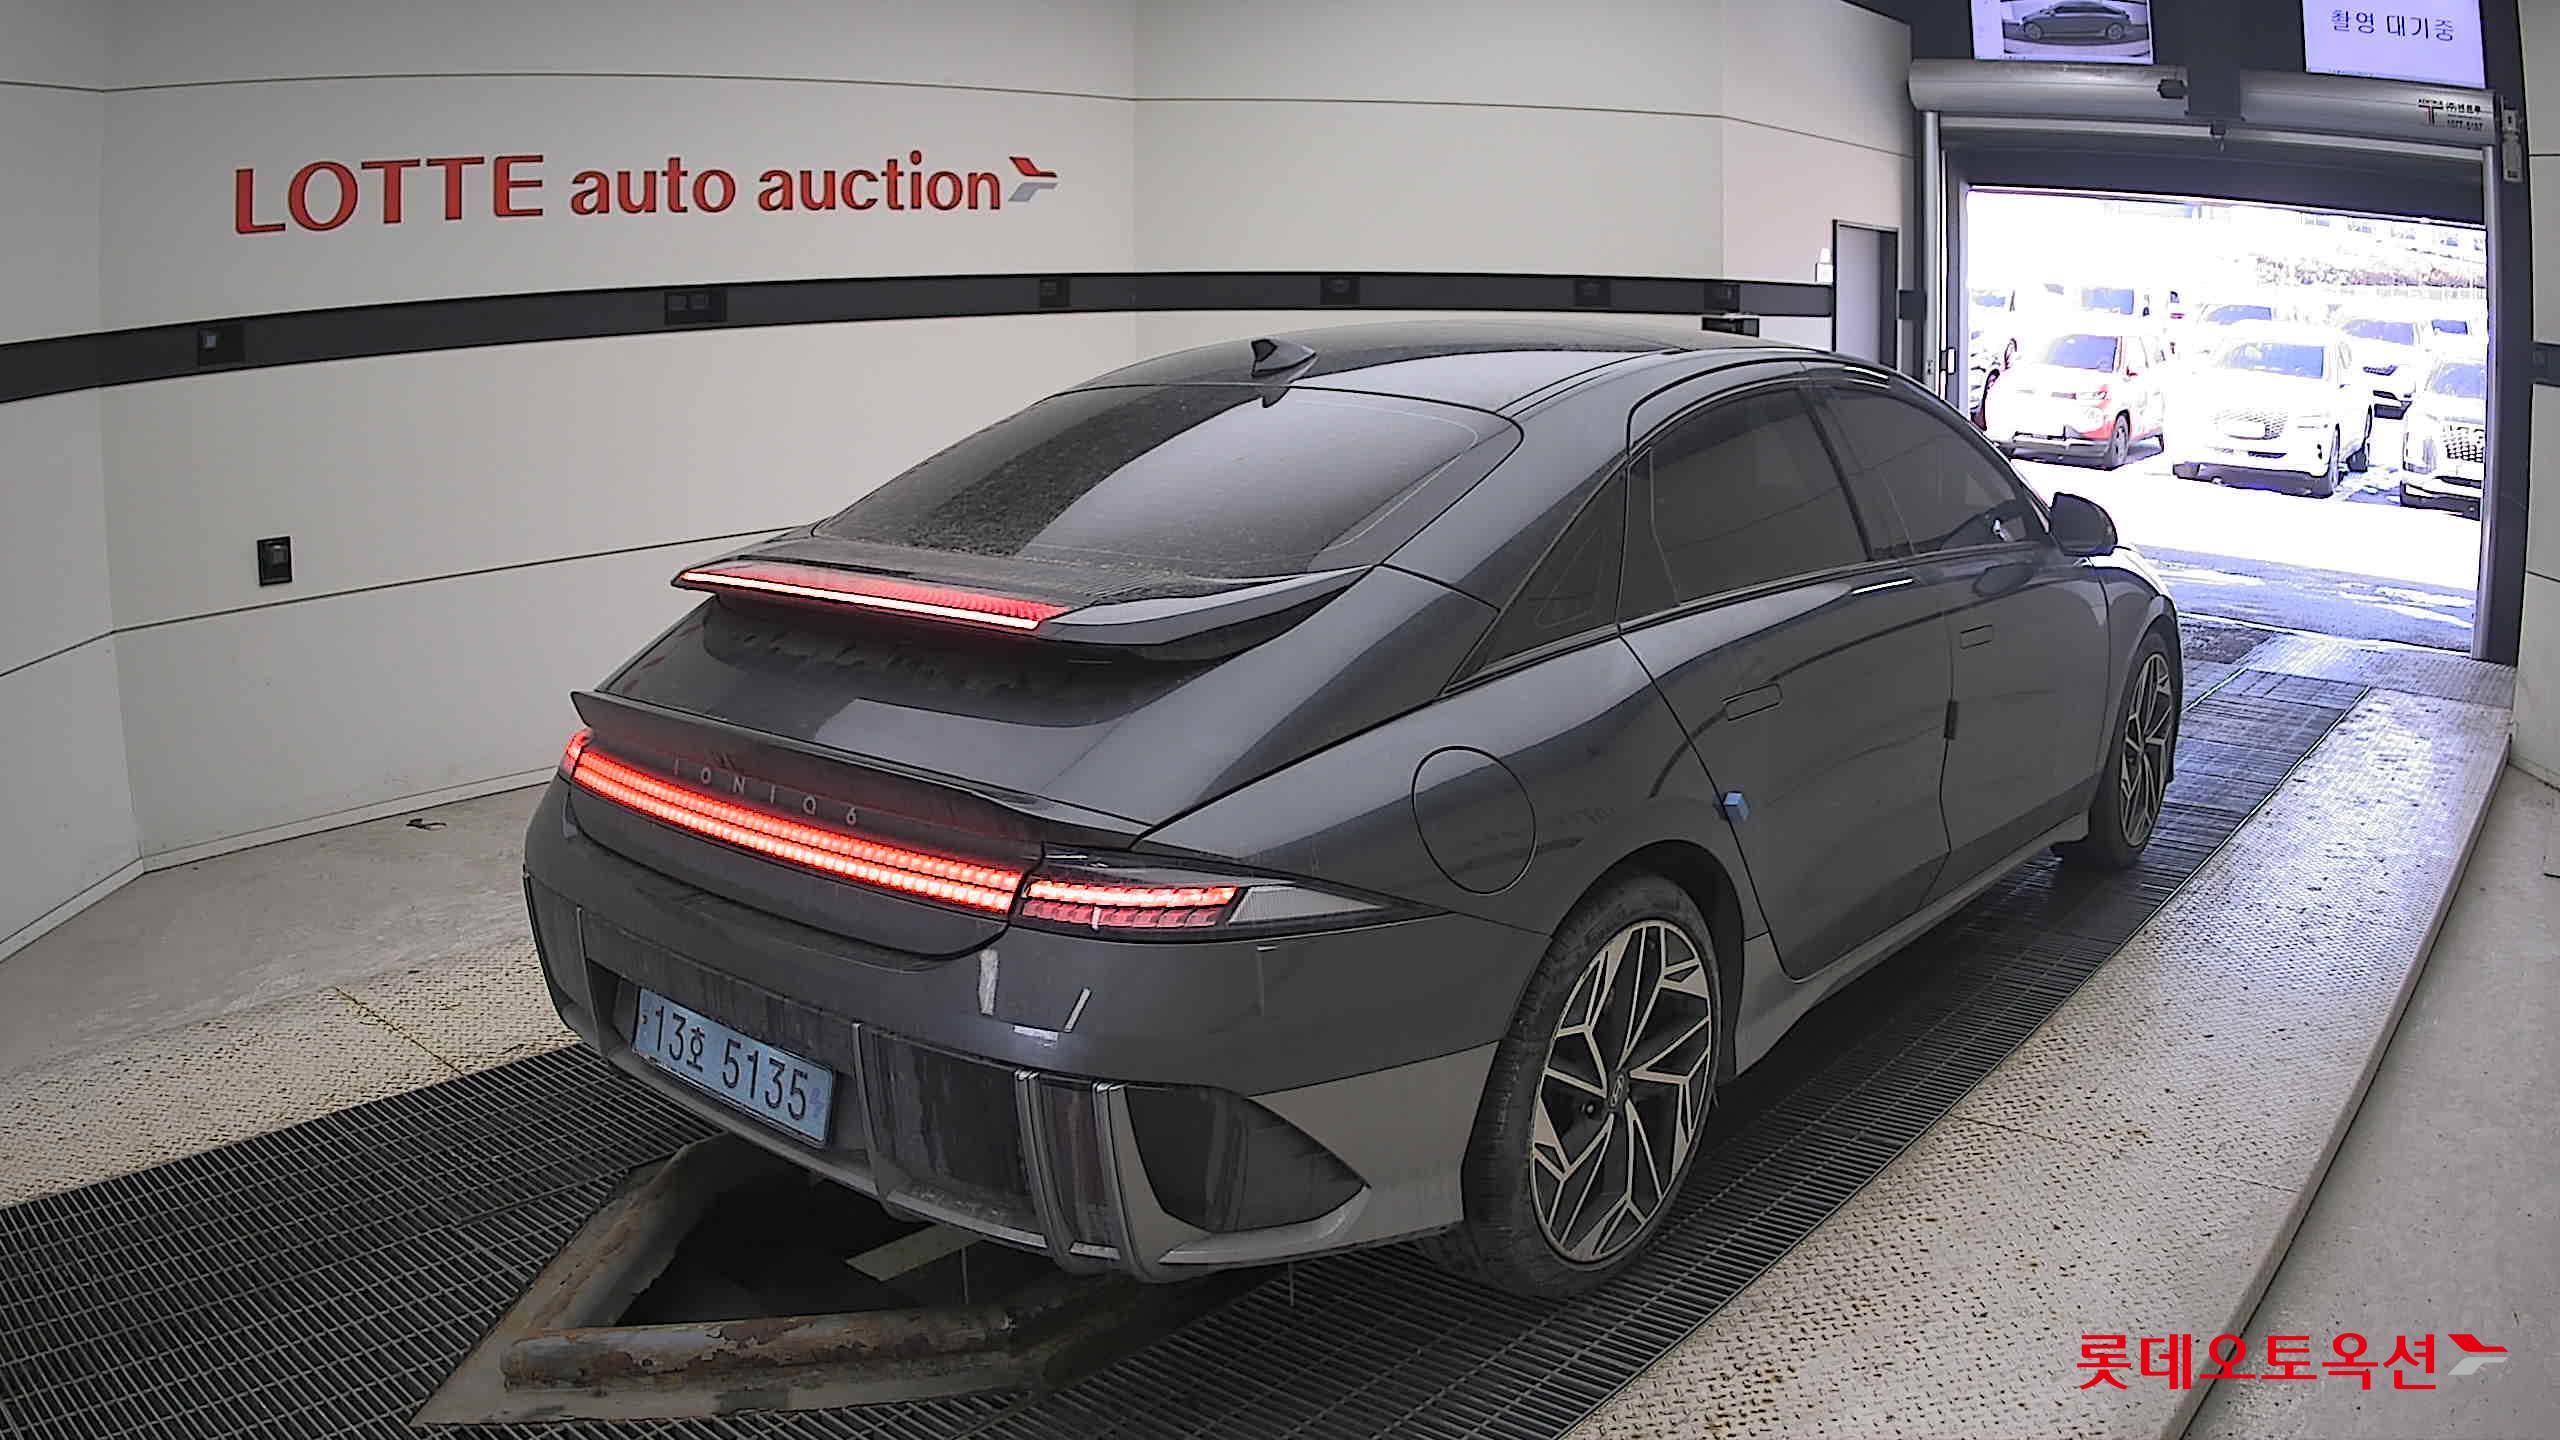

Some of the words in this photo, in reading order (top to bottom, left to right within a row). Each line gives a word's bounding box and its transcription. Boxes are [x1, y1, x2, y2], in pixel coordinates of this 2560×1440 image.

[2331, 9, 2376, 34] 촬영
[2386, 15, 2455, 42] 대기중
[236, 153, 542, 234] LOTTE
[570, 157, 738, 215] auto
[758, 150, 1003, 212] auction
[673, 758, 817, 815] IONIQ
[845, 806, 857, 826] 6
[655, 1005, 706, 1073] 13호
[721, 1037, 809, 1121] 5135
